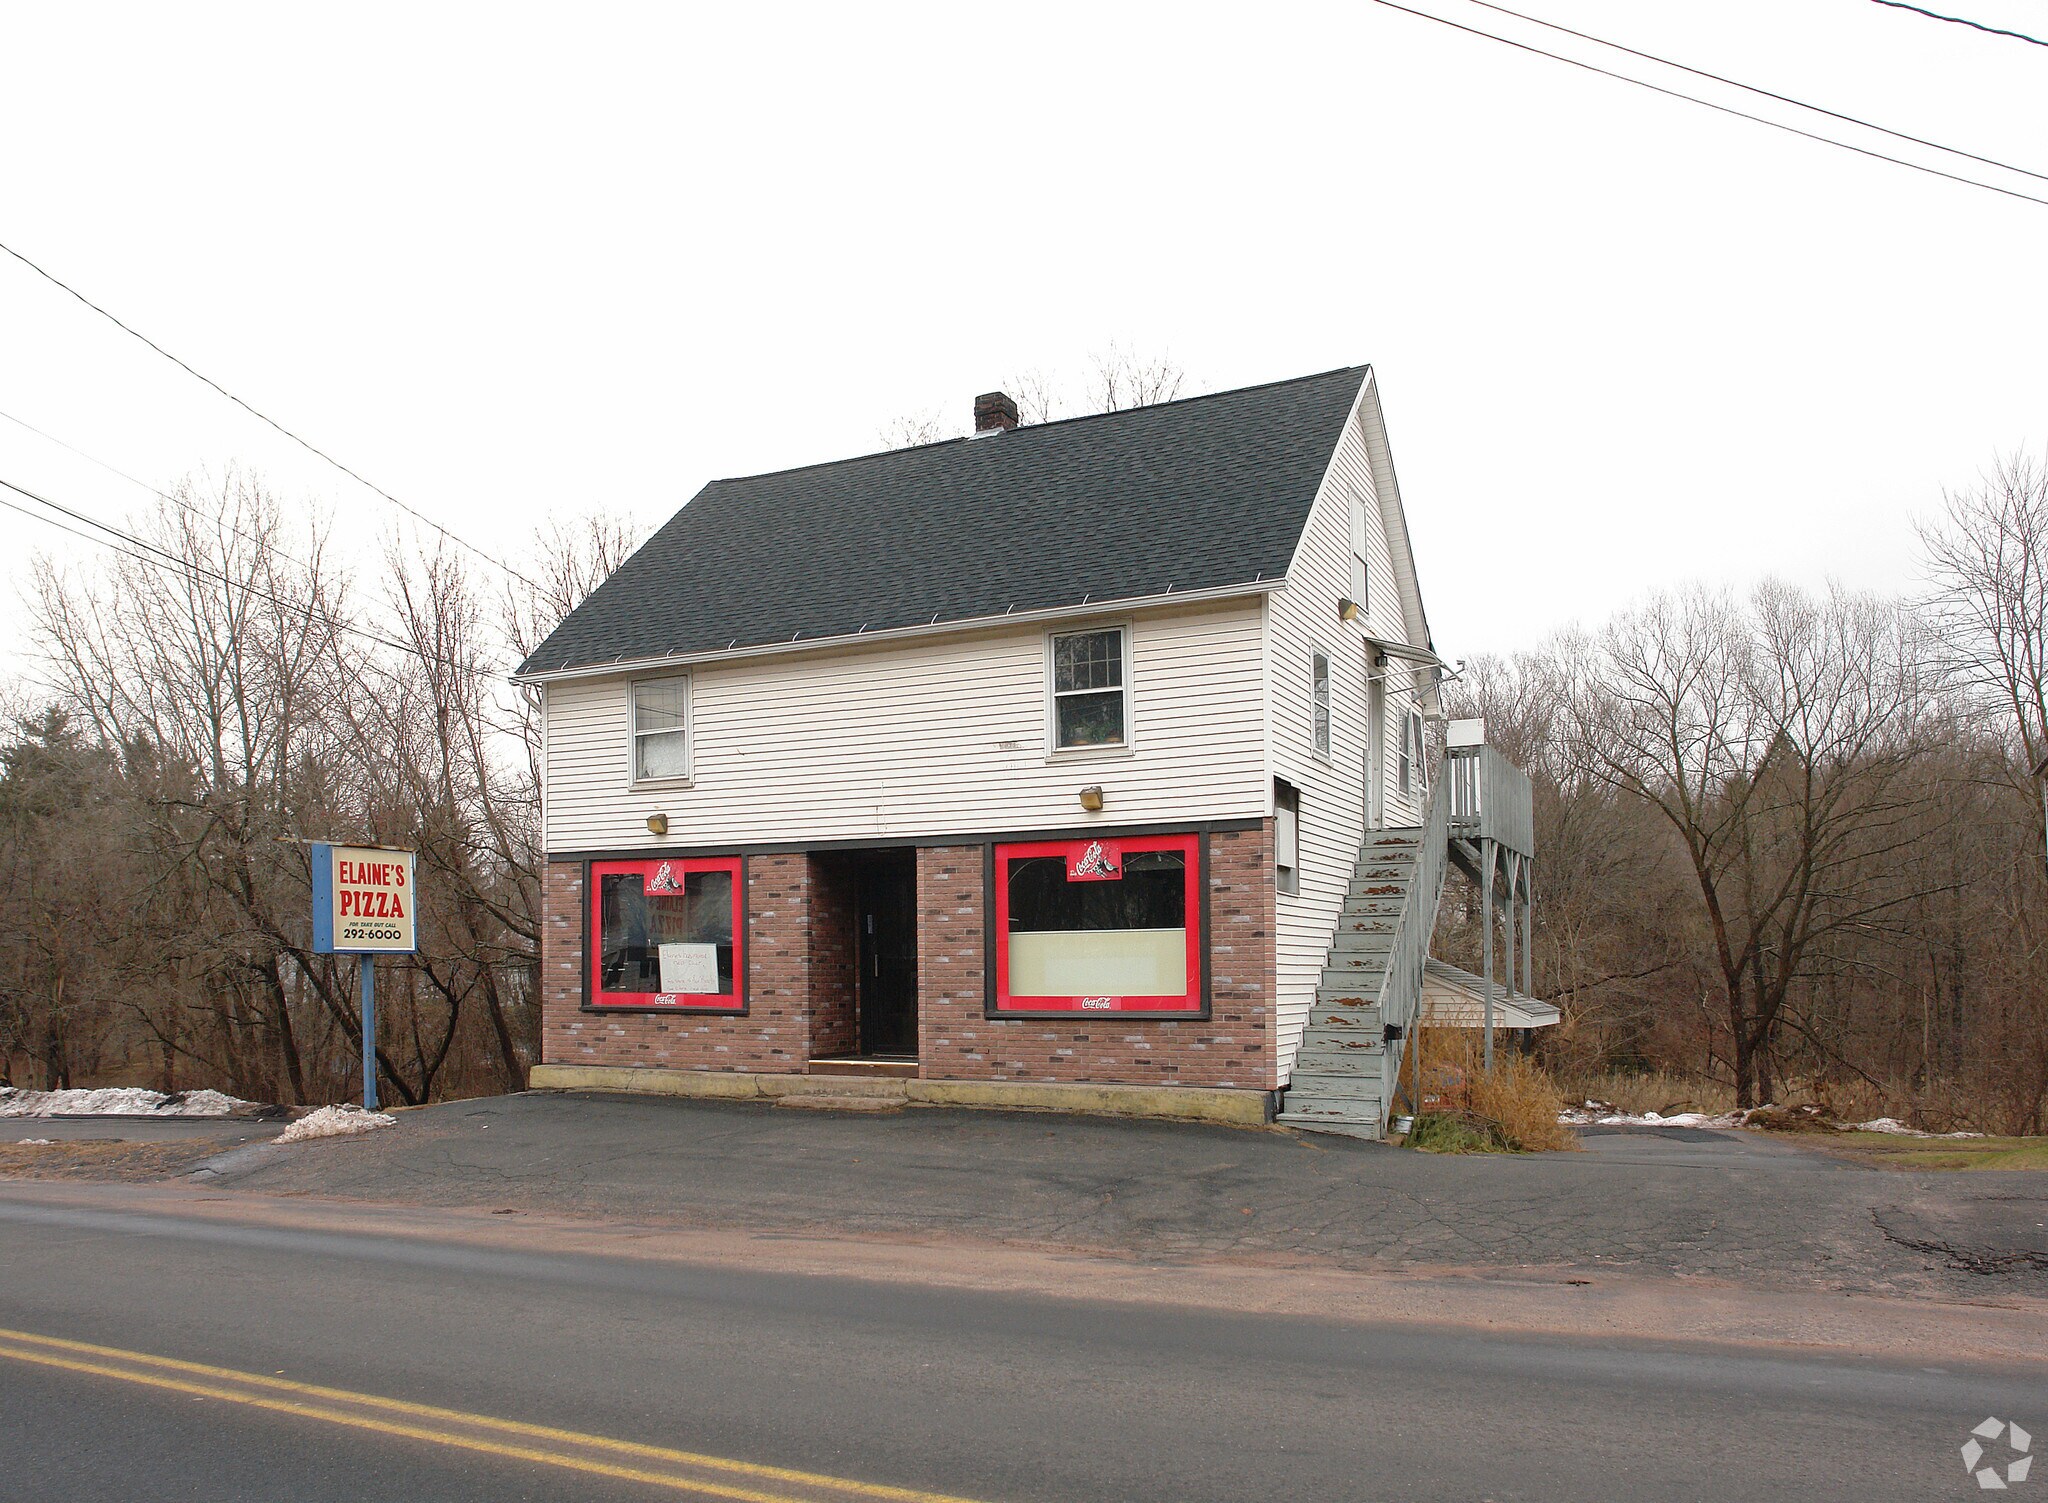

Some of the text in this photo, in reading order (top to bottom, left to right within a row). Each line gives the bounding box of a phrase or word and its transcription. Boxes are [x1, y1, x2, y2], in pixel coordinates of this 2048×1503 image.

[339, 861, 405, 887] ELAINE'S
[340, 890, 404, 918] PIZZA
[343, 928, 402, 940] 292-6000
